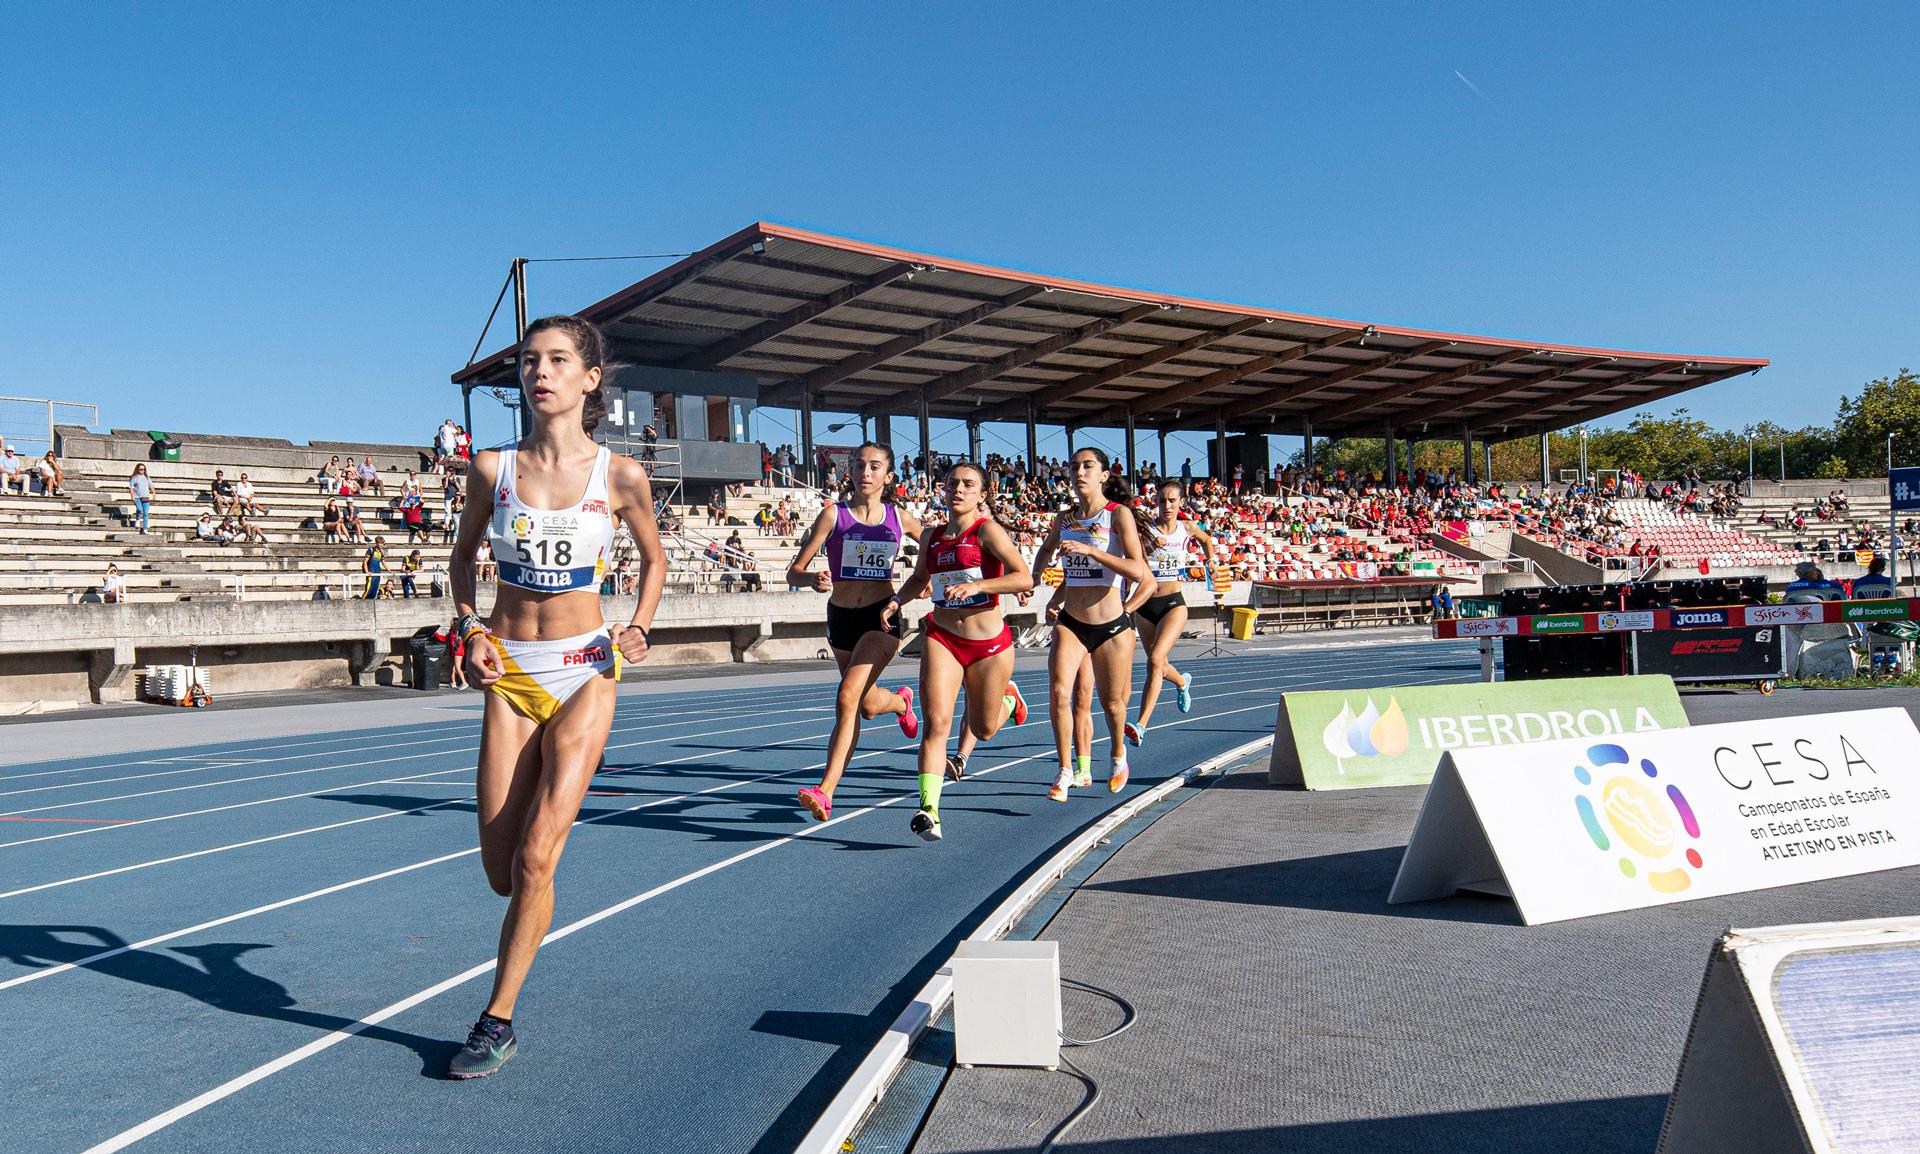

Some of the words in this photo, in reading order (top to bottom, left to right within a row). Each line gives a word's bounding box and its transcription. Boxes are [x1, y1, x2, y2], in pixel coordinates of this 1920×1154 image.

[582, 502, 608, 515] FAMU
[542, 516, 578, 525] CESA
[516, 539, 572, 566] 518
[857, 554, 885, 567] 146
[1066, 556, 1089, 567] 344
[1158, 560, 1178, 569] 634
[518, 568, 572, 587] Joma
[854, 568, 885, 577] Joma
[1753, 605, 1790, 623] gijón
[1864, 606, 1904, 616] Iberdrola
[1549, 620, 1580, 628] Iberdrola
[1676, 611, 1723, 625] Joma
[1760, 631, 1769, 641] 5
[563, 650, 606, 665] FAMU
[1764, 654, 1769, 662] 5
[1714, 734, 1876, 790] CESA
[1738, 796, 1827, 818] Campeonatos
[1828, 792, 1846, 806] de
[1845, 786, 1891, 804] España
[1750, 826, 1768, 840] en
[1767, 819, 1803, 837] Edad
[1803, 814, 1850, 833] Escolar
[1762, 837, 1836, 861] ATLETISMO
[1837, 835, 1857, 850] EN
[1857, 829, 1896, 847] PISTA
